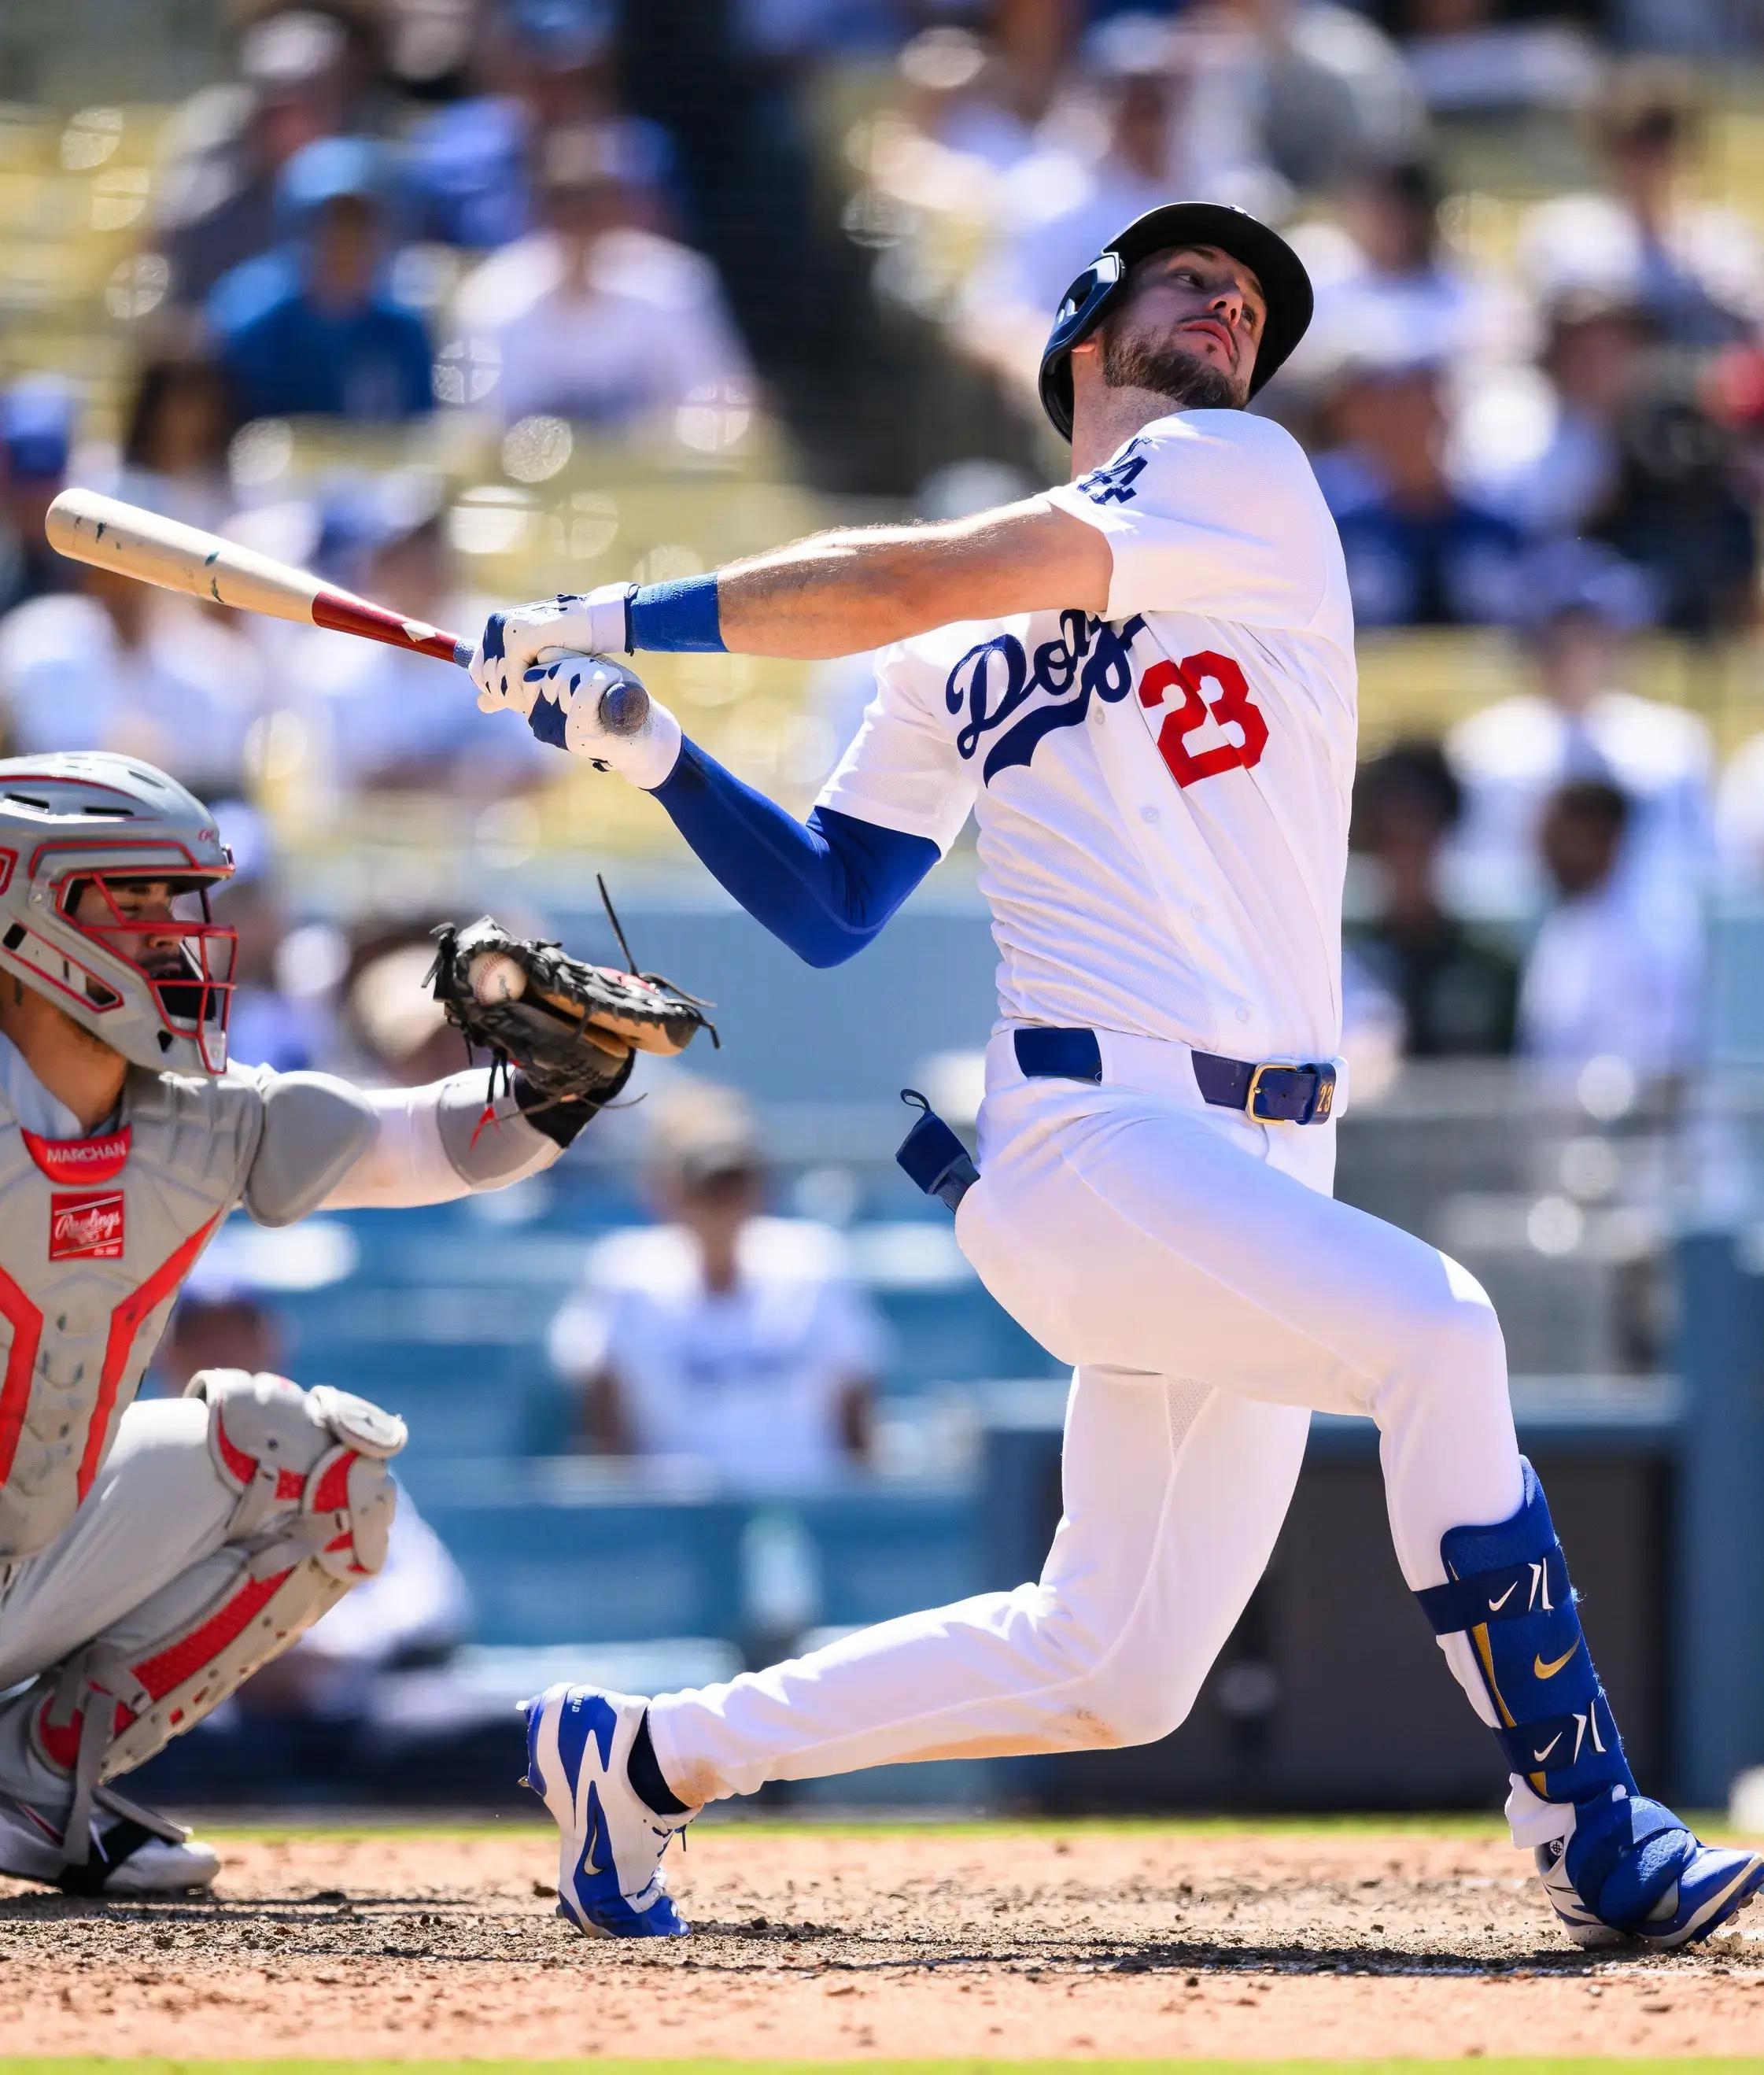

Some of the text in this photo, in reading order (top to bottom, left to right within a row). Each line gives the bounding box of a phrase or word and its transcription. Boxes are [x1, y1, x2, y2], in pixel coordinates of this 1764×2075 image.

[1138, 650, 1269, 788] 23
[1316, 1081, 1334, 1113] 23
[46, 1140, 126, 1164] MARCHAN
